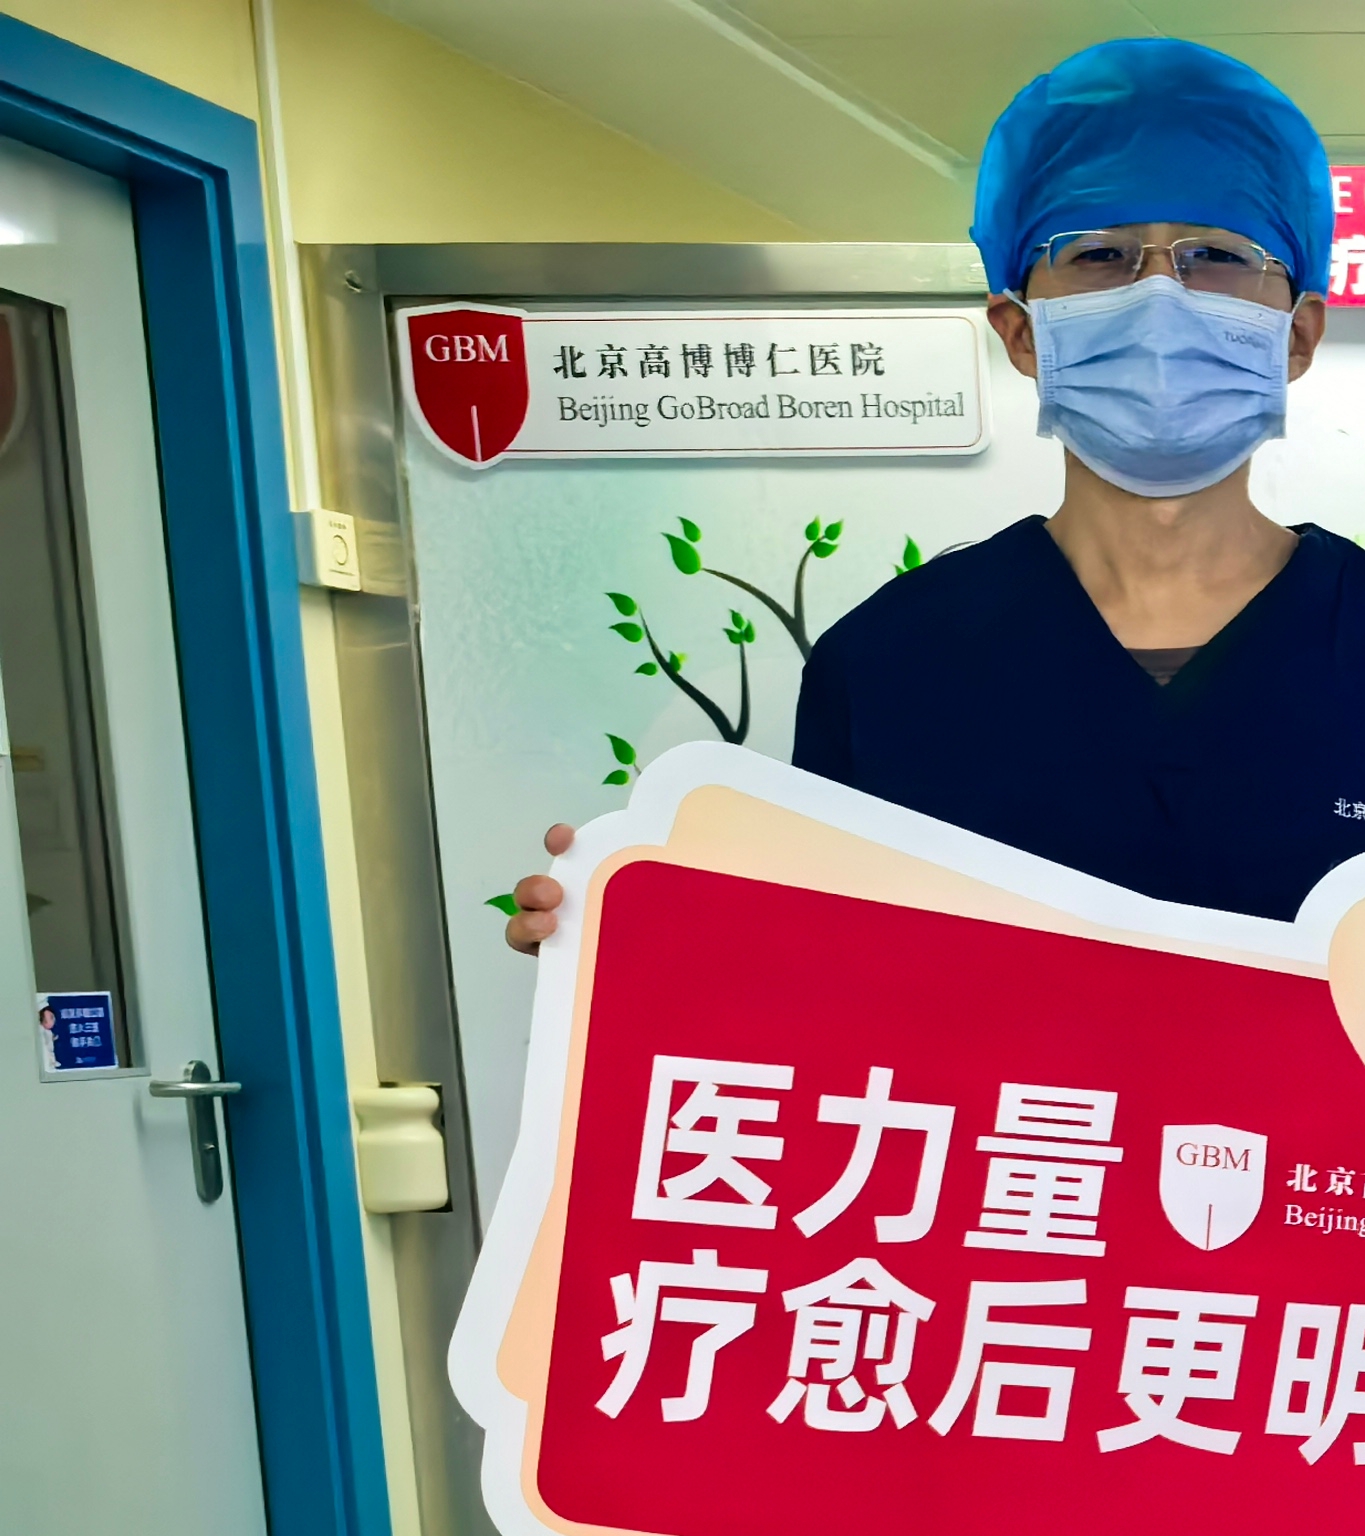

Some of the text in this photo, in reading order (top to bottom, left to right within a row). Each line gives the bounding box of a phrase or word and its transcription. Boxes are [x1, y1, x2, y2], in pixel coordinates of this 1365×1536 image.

[424, 334, 511, 364] GBM
[553, 342, 886, 380] 北京高博博仁医院
[559, 391, 965, 428] Beijing GoBroad Boren Hospital
[631, 1054, 1124, 1258] 医力量
[1175, 1141, 1252, 1172] GBM
